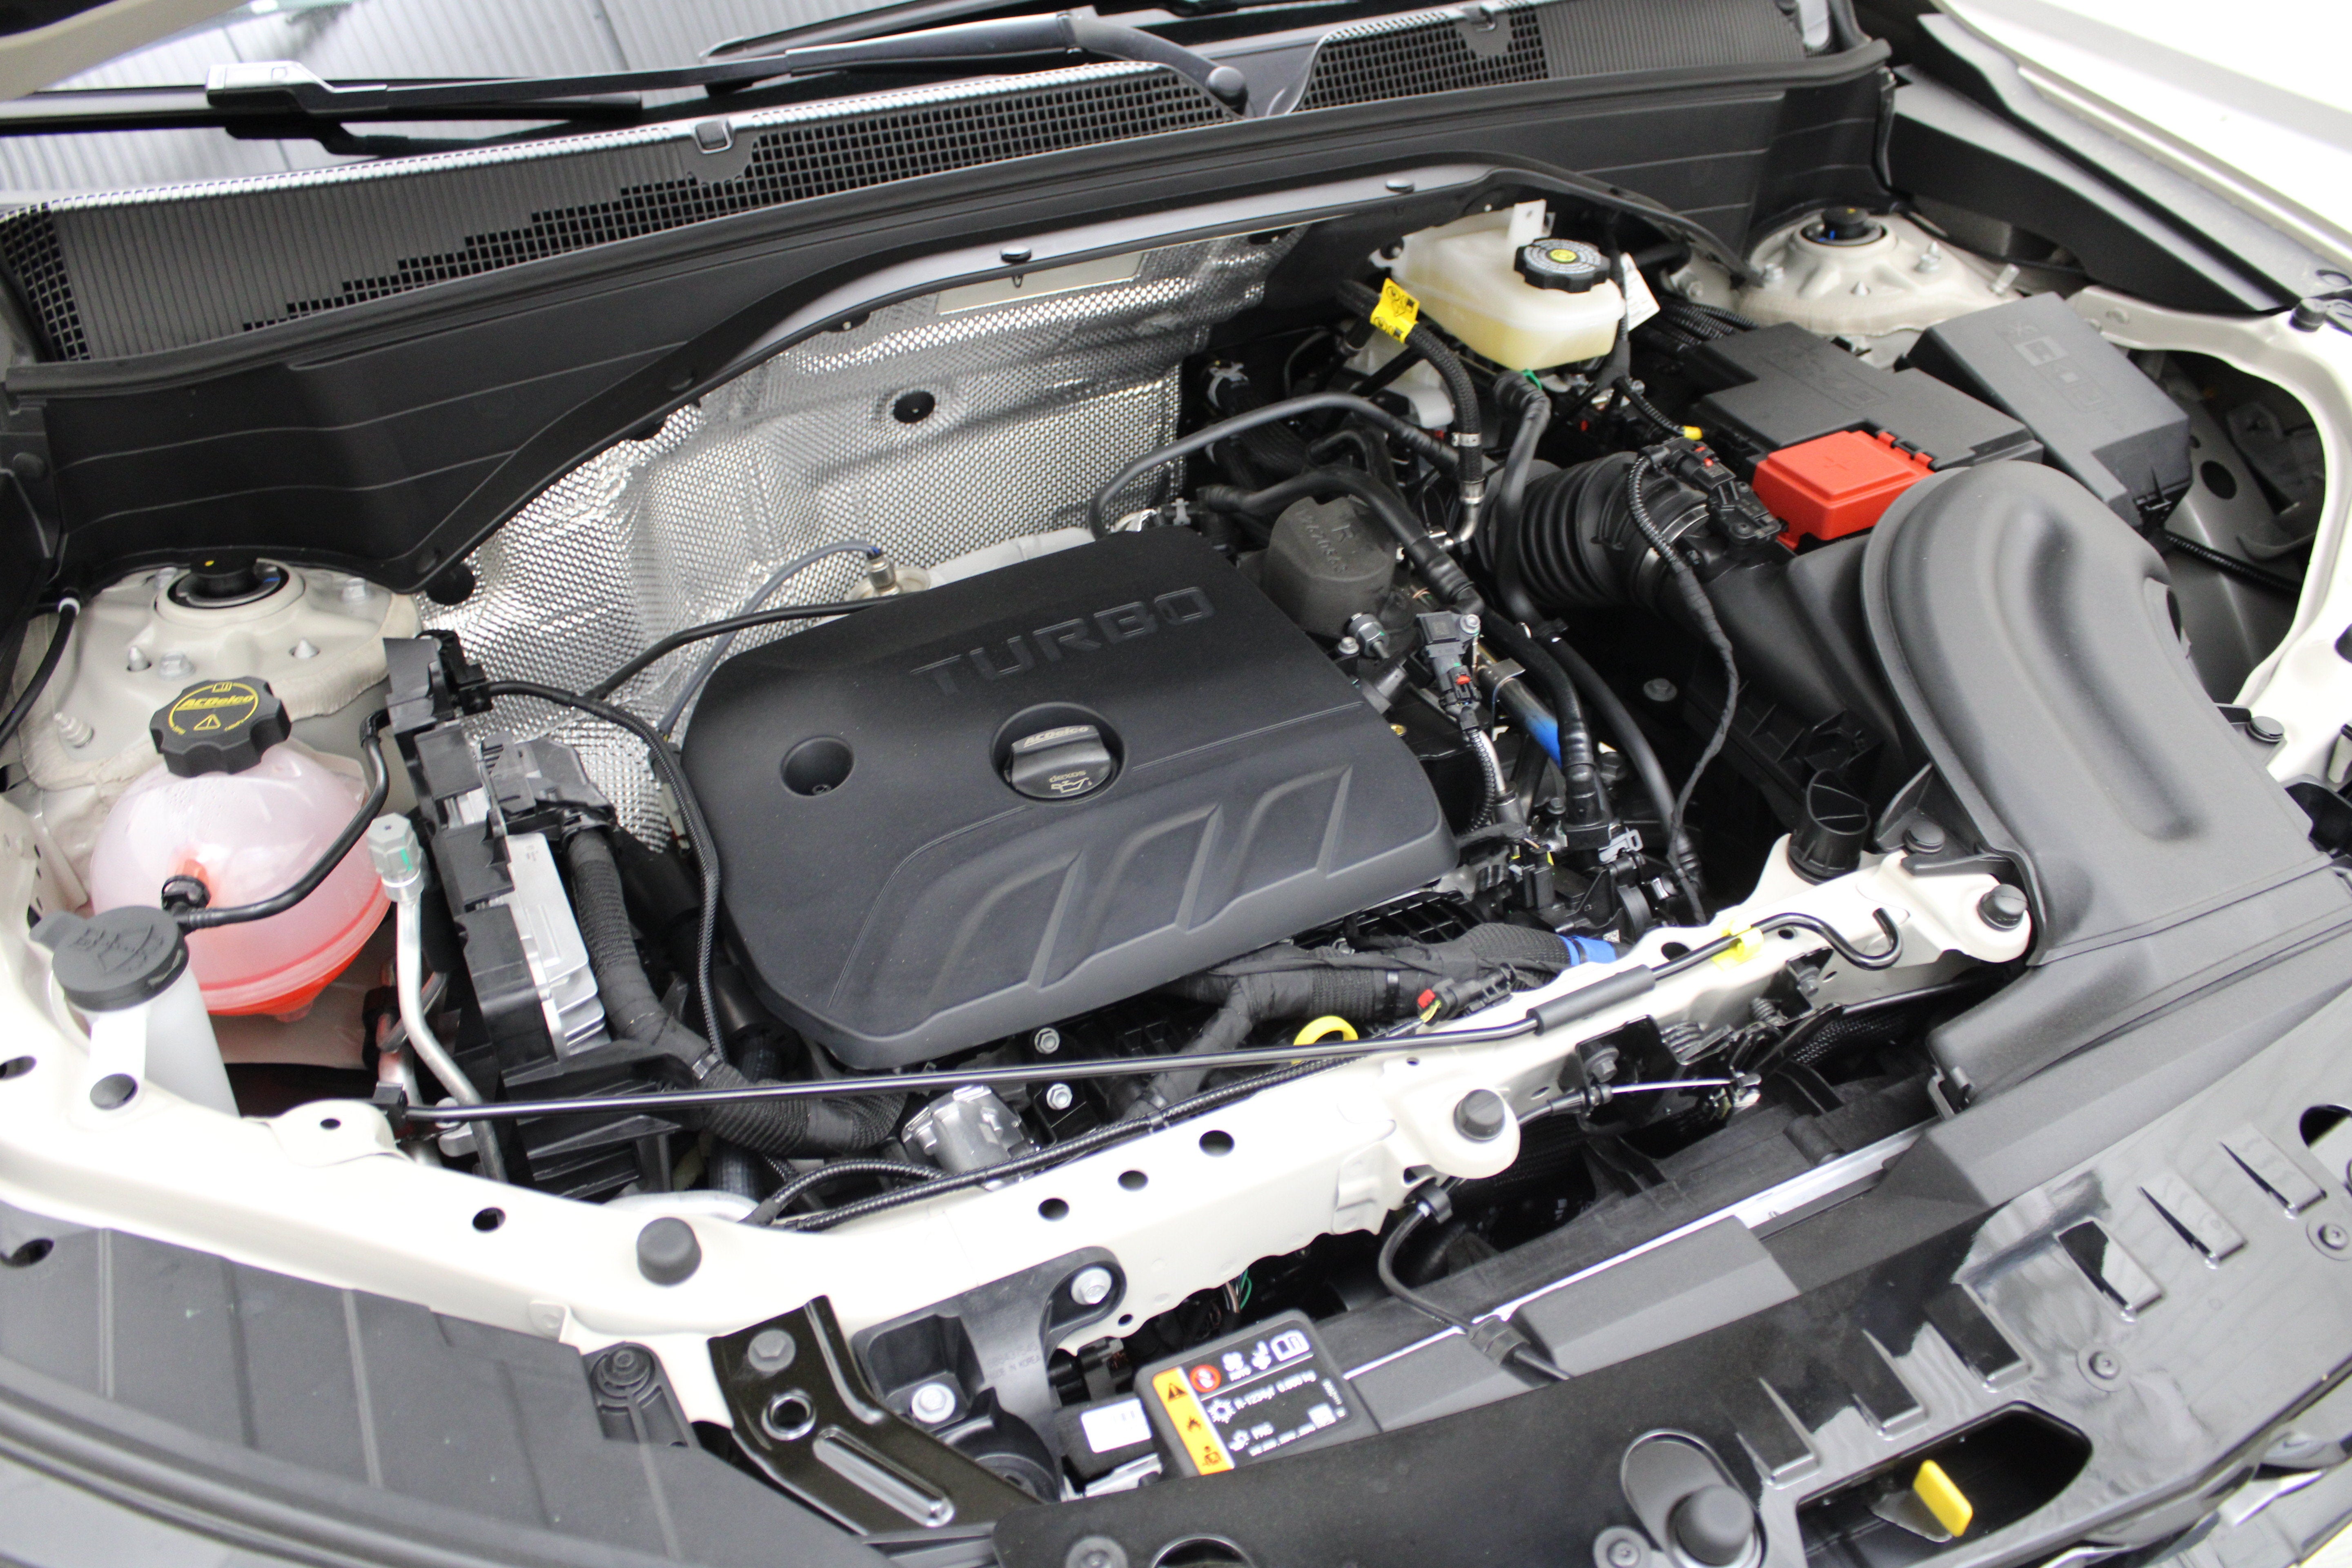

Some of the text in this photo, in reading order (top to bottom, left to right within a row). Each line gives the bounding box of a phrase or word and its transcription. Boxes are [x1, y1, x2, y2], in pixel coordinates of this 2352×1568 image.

[910, 586, 1215, 695] TURBO
[176, 695, 255, 711] ACDelco
[1024, 726, 1089, 748] ACDelco
[1049, 770, 1087, 783] dexos
